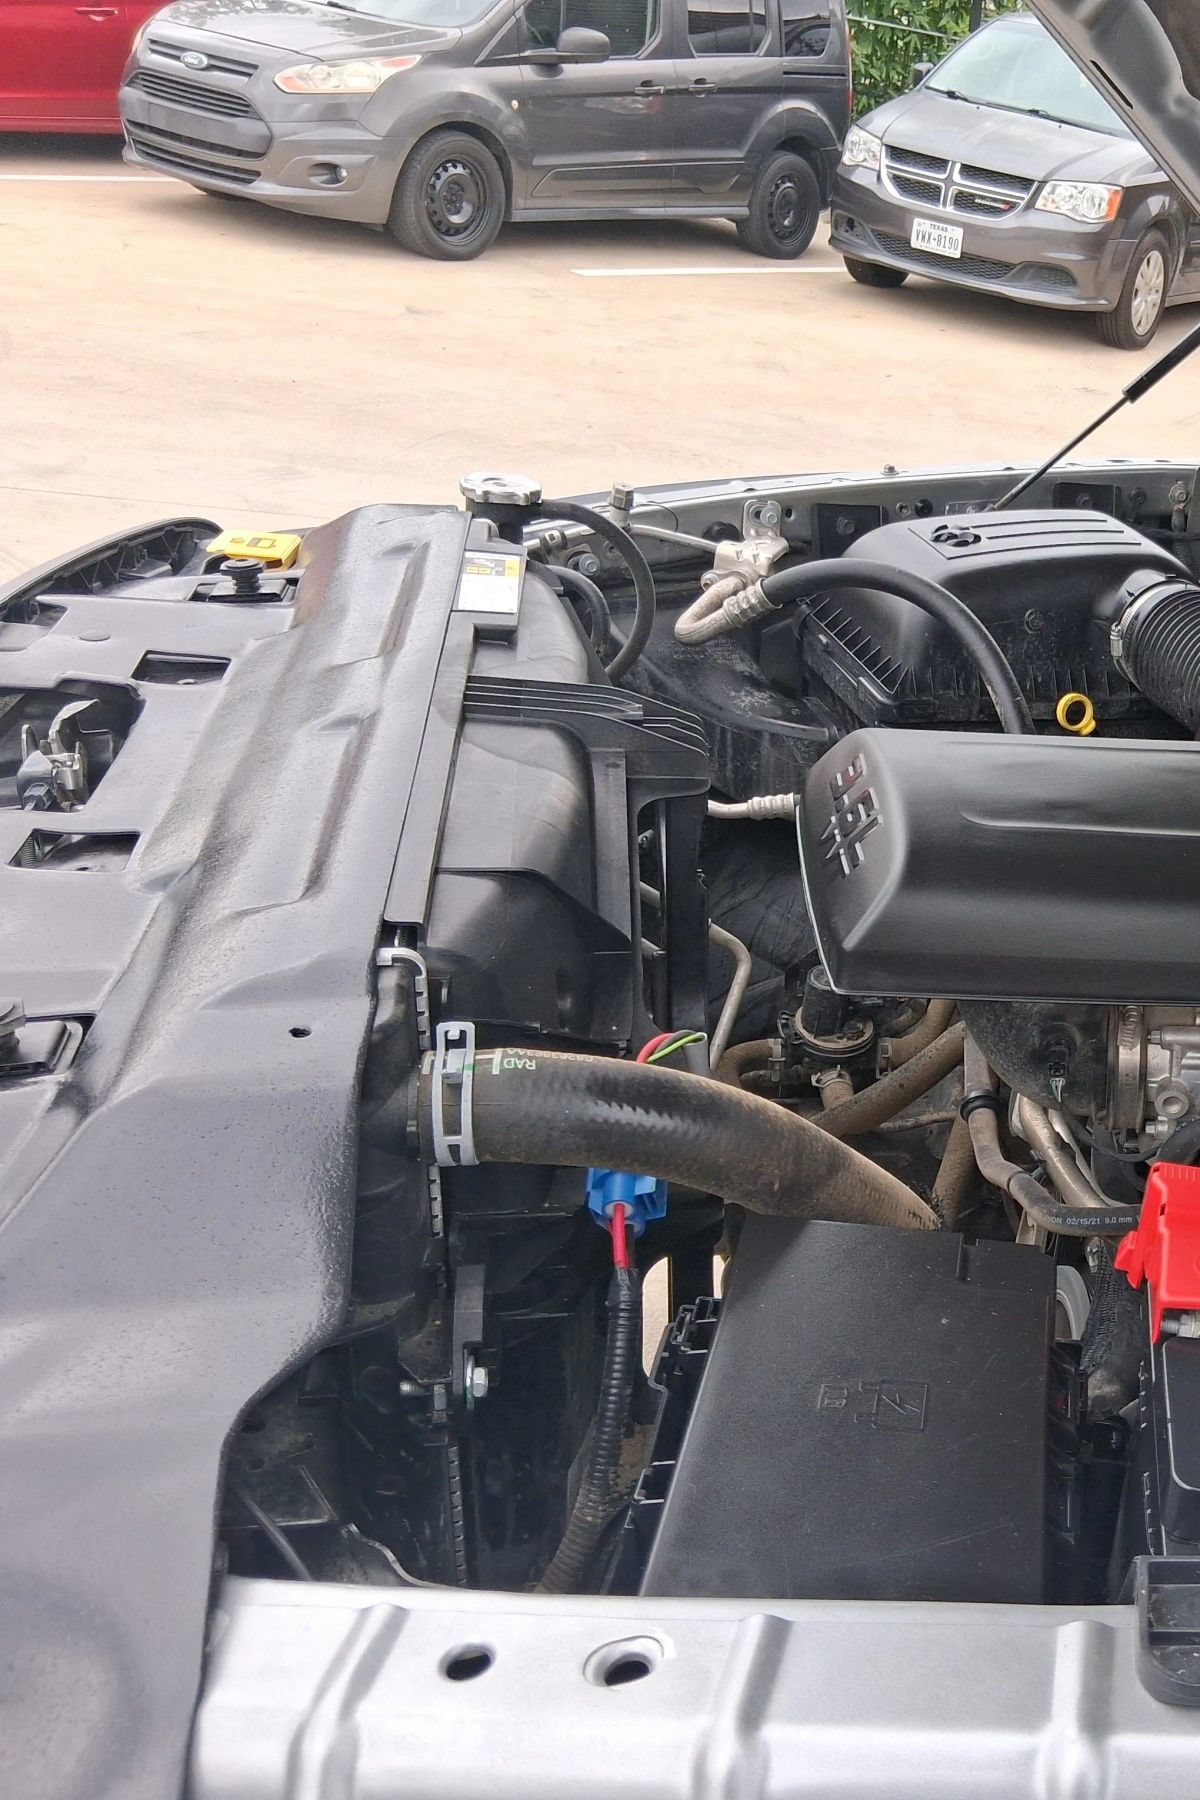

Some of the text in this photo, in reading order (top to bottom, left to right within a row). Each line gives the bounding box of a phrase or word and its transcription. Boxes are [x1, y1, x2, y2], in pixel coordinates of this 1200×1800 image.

[930, 224, 948, 232] TEXAS
[503, 1058, 536, 1070] RAD
[1066, 1217, 1100, 1225] 02/15/21
